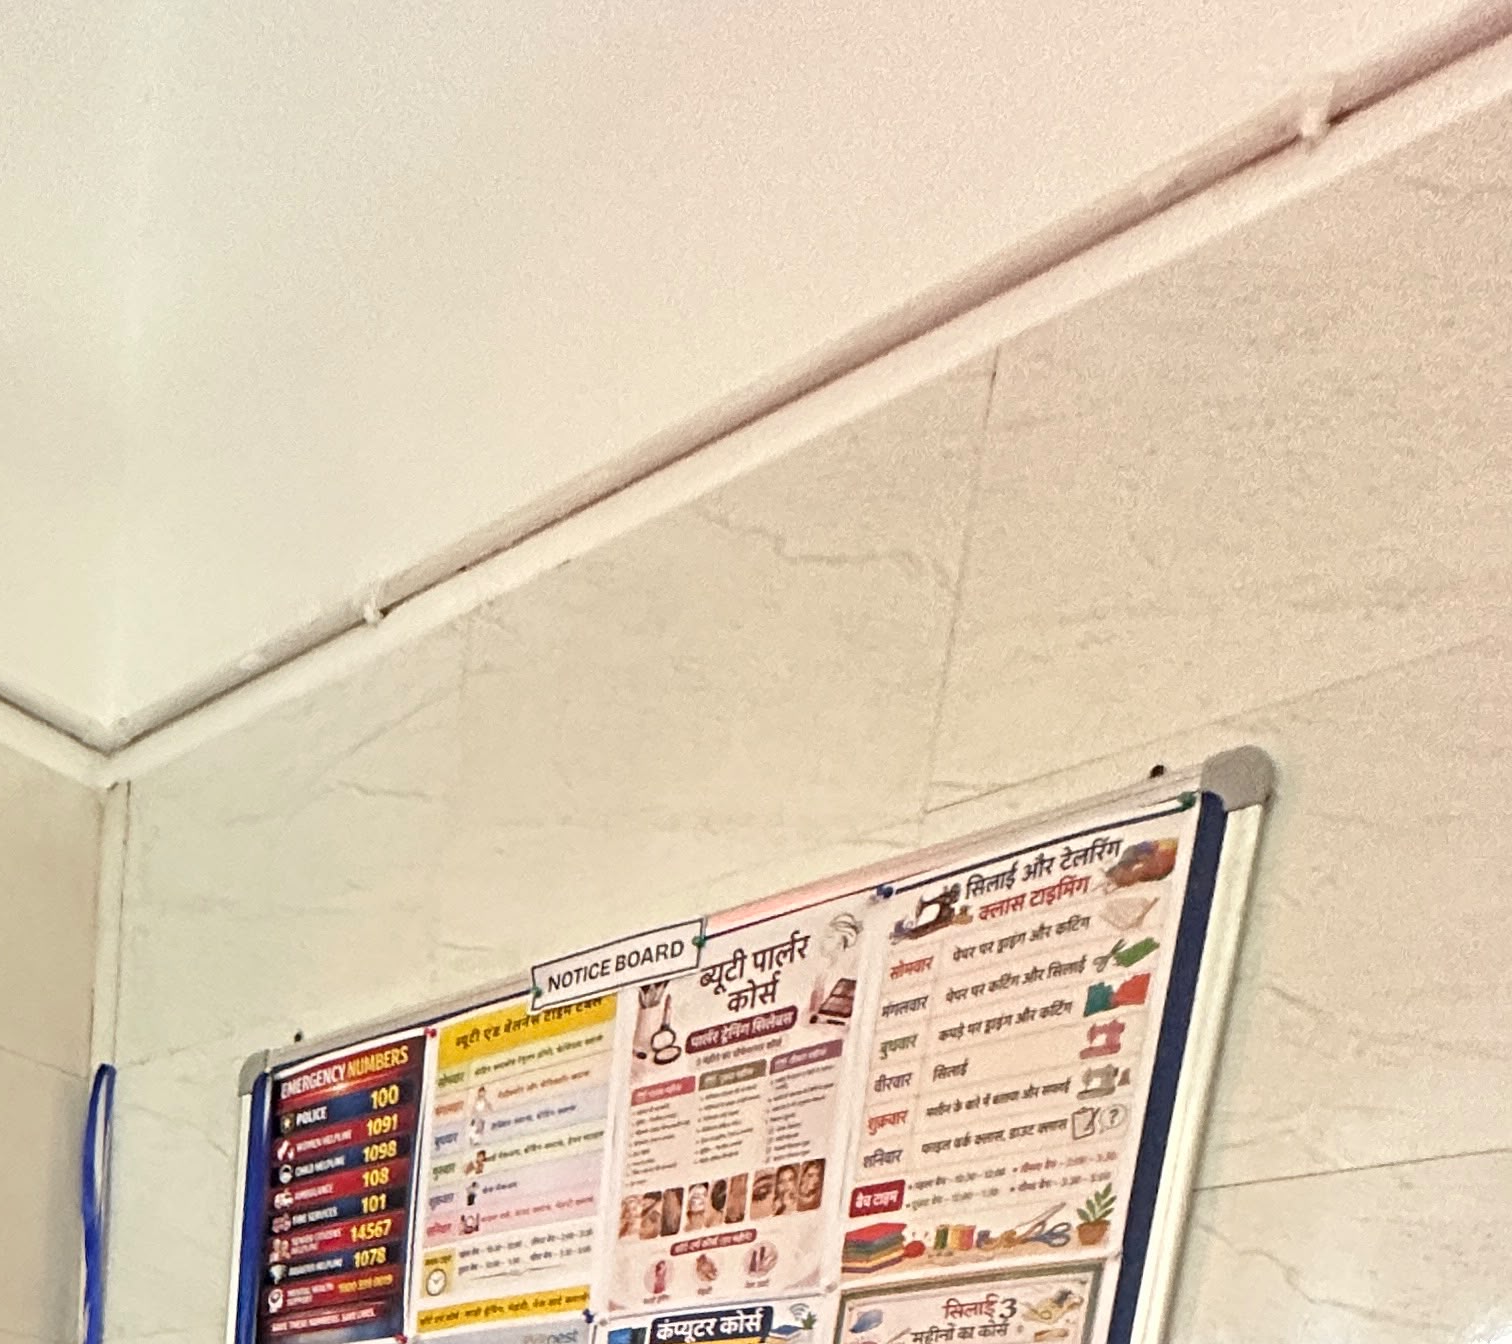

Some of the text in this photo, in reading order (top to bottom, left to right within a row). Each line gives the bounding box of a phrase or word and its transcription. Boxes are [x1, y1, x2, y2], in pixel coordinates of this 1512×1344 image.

[965, 837, 1124, 901] सिलाई और टेलरिंग
[978, 874, 1092, 921] क्लास टाइमिंग
[1029, 921, 1052, 942] और
[547, 940, 685, 993] NOTICE BOARD
[699, 930, 811, 996] ब्यूटी पार्लर
[890, 955, 934, 980] सोमवार
[971, 984, 986, 998] पर
[1022, 965, 1045, 985] और
[1047, 954, 1088, 980] सिलाई
[727, 970, 781, 1013] कोर्स
[881, 994, 929, 1018] मंगलवार
[1015, 1006, 1037, 1025] और
[879, 1033, 918, 1060] बुधवार
[281, 1045, 409, 1099] EMERGENCY NUMBERS
[933, 1058, 969, 1082] सिलाई
[874, 1072, 913, 1093] वीरवार
[296, 1084, 399, 1126] POLICE 100
[367, 1114, 398, 1136] 1091
[363, 1140, 397, 1162] 1098
[863, 1148, 904, 1168] शनिवार
[363, 1167, 389, 1187] 108
[361, 1193, 387, 1214] 101
[350, 1219, 392, 1243] 14567
[354, 1246, 387, 1269] 1078
[943, 1292, 1018, 1320] सिलाई 3
[656, 1307, 764, 1343] कंप्यूटर कोर्स
[956, 1325, 975, 1340] का
[978, 1317, 1011, 1338] कोर्स
